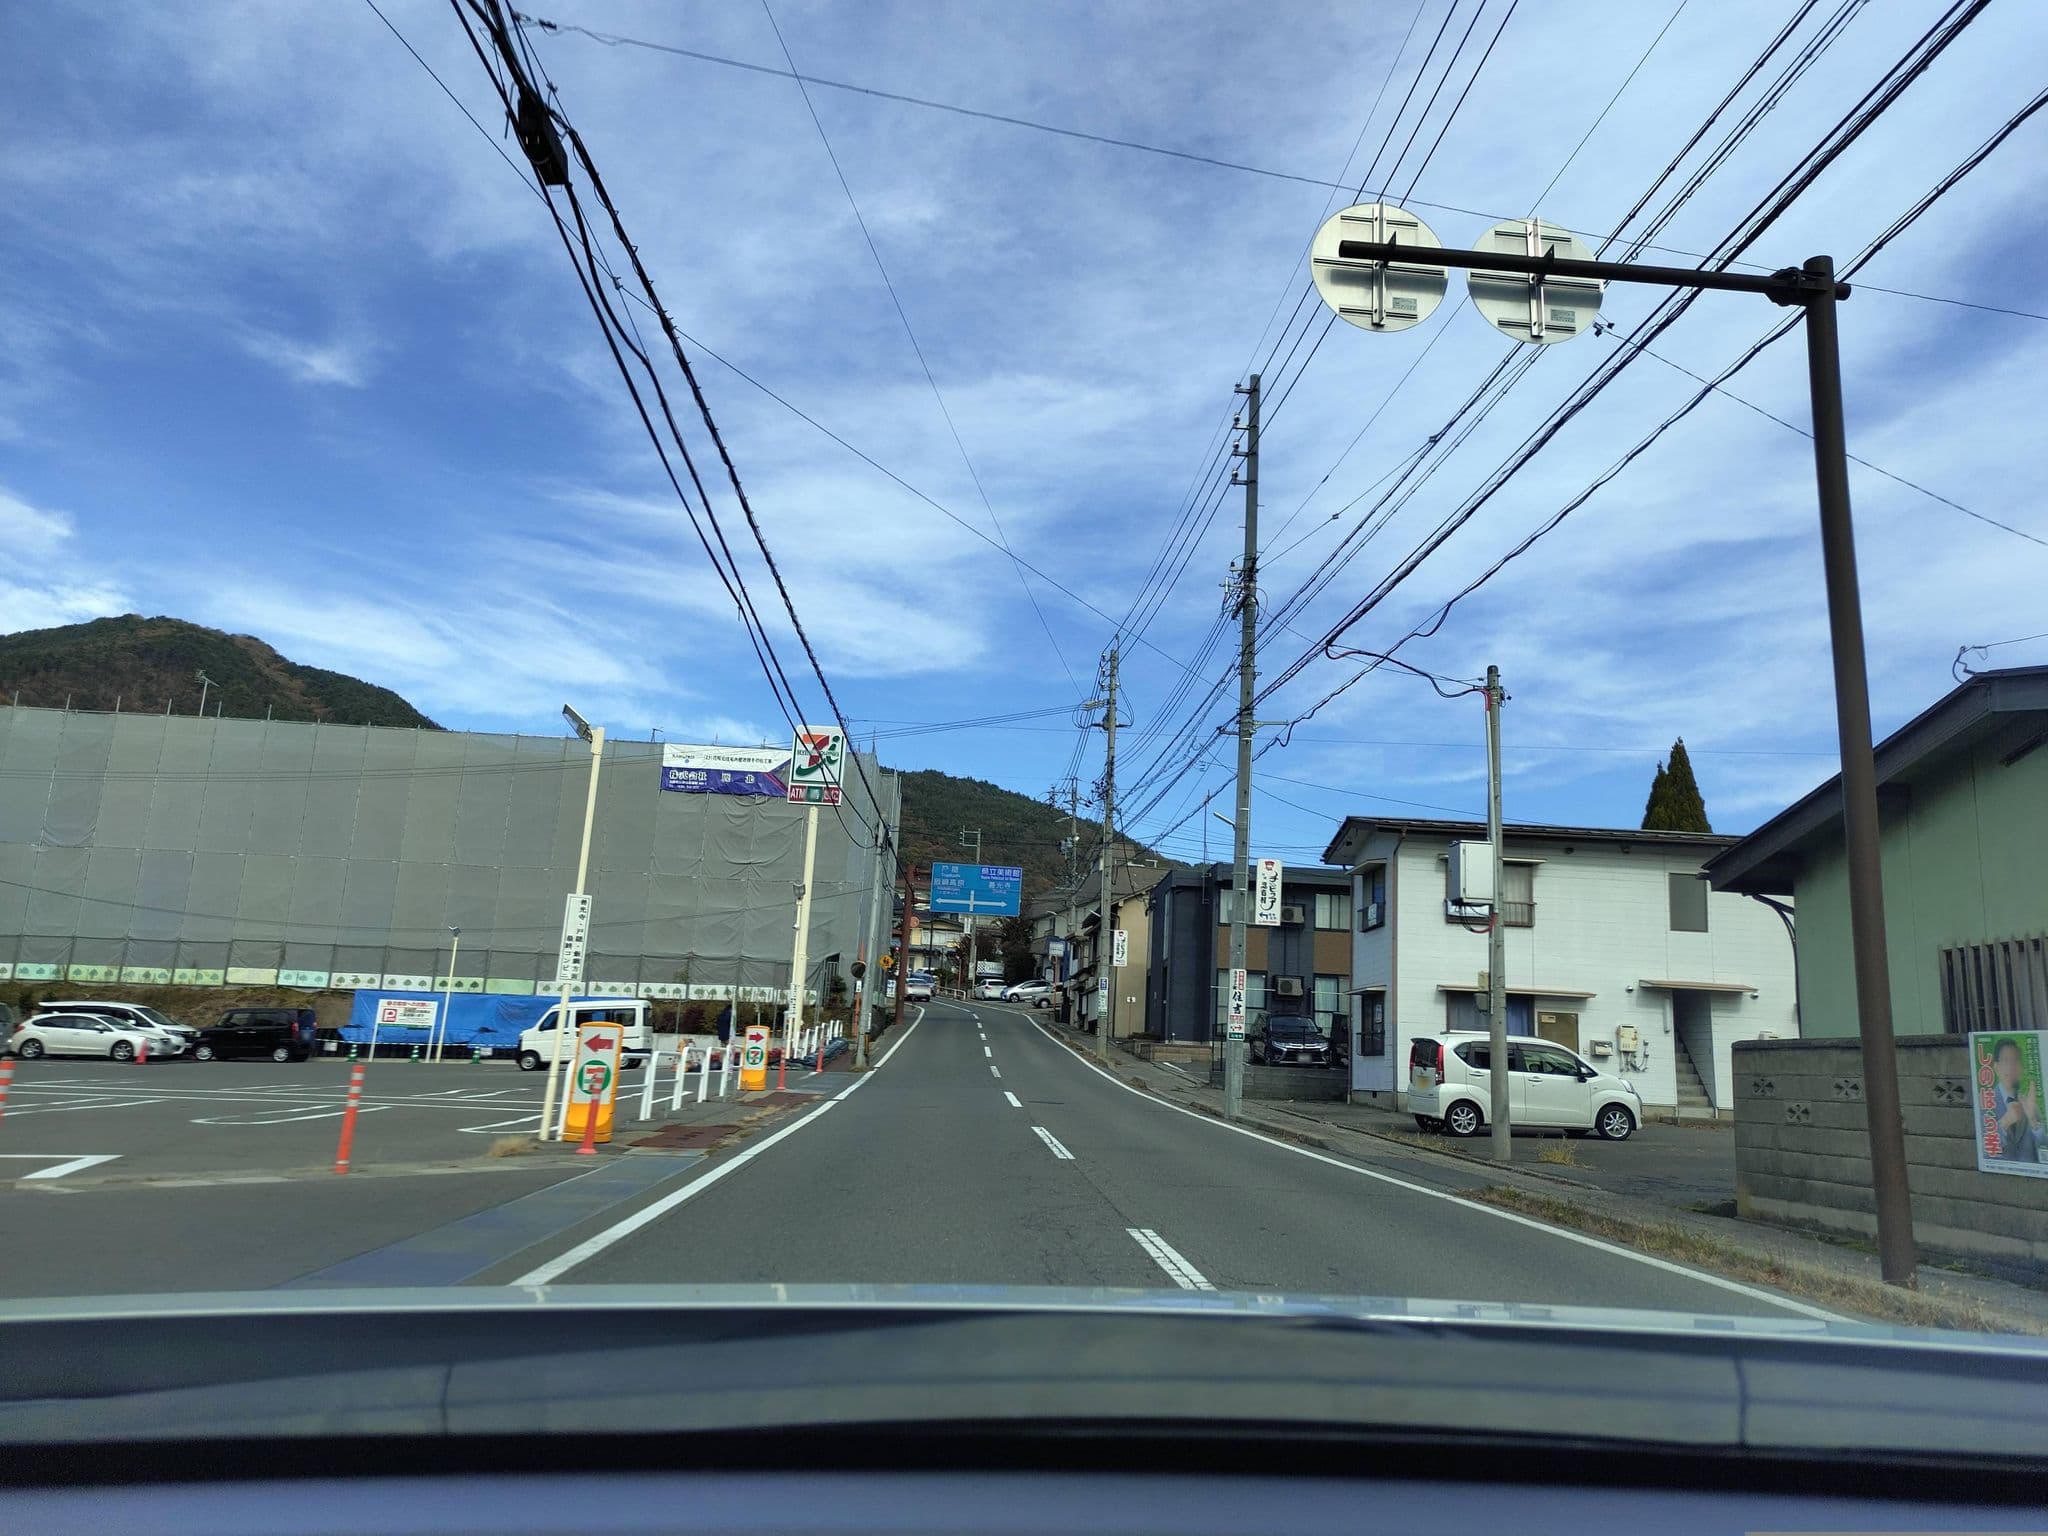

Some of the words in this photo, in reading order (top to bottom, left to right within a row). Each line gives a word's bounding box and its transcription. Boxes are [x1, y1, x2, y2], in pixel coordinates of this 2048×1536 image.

[1977, 1043, 2002, 1157] しのはら孝
